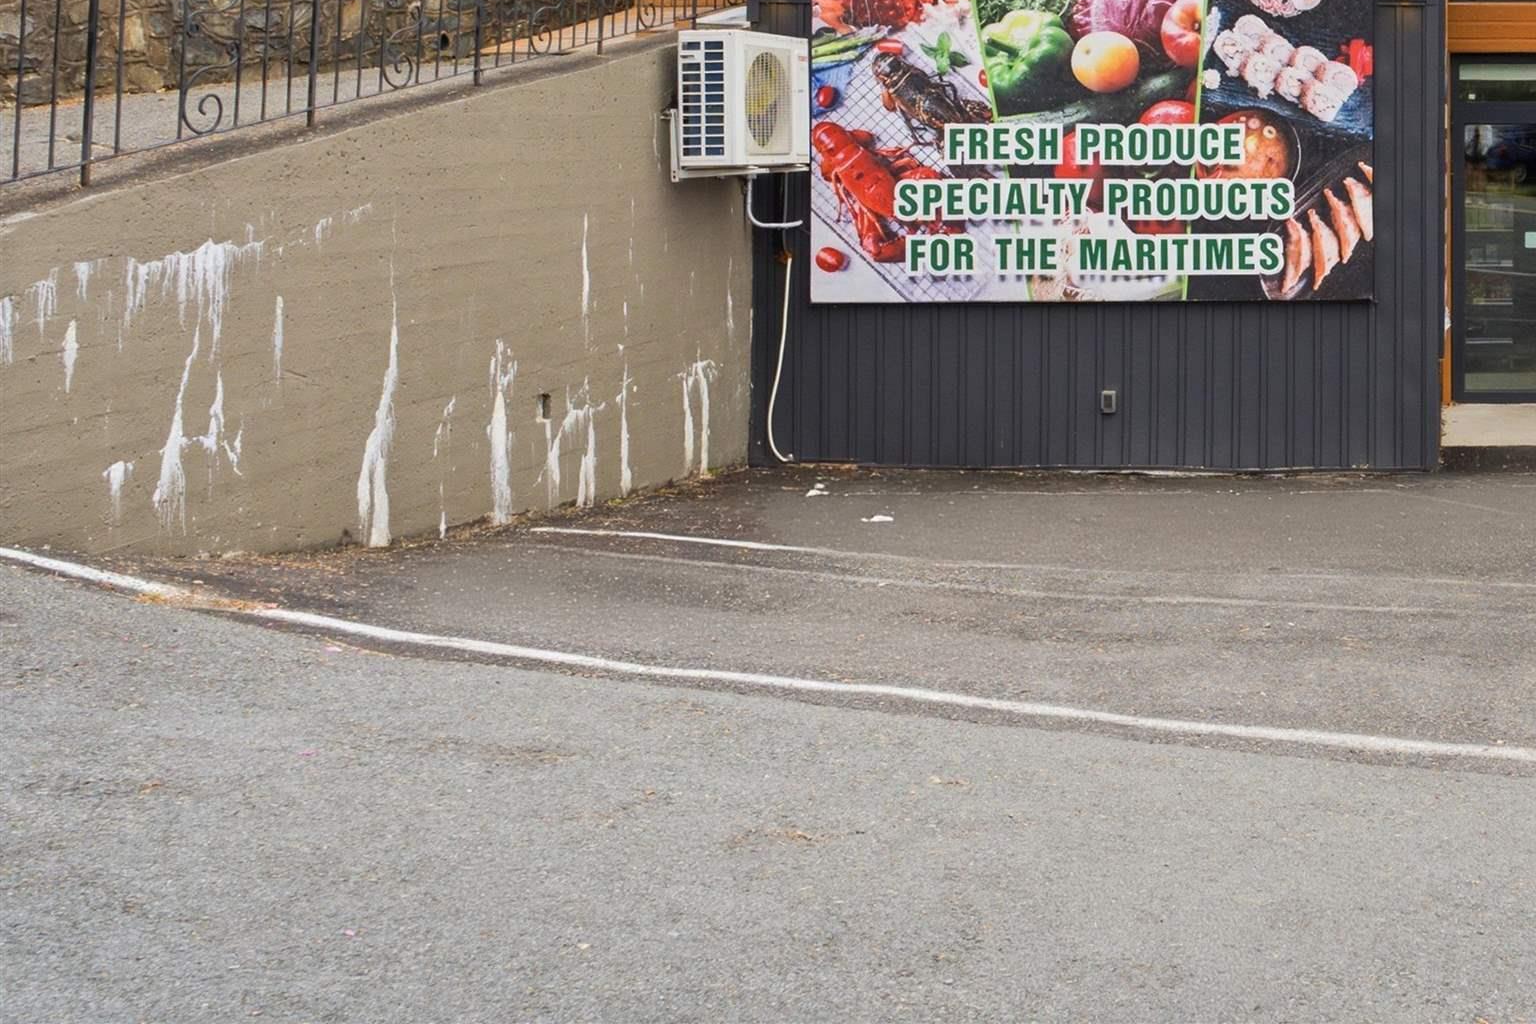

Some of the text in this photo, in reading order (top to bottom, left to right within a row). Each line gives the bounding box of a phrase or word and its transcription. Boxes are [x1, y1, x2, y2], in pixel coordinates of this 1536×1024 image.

[946, 126, 1245, 162] FRESH PRODUCE
[896, 181, 1293, 217] SPECIALTY PRODUCTS
[909, 235, 1284, 273] FOR THE MARITIMES
